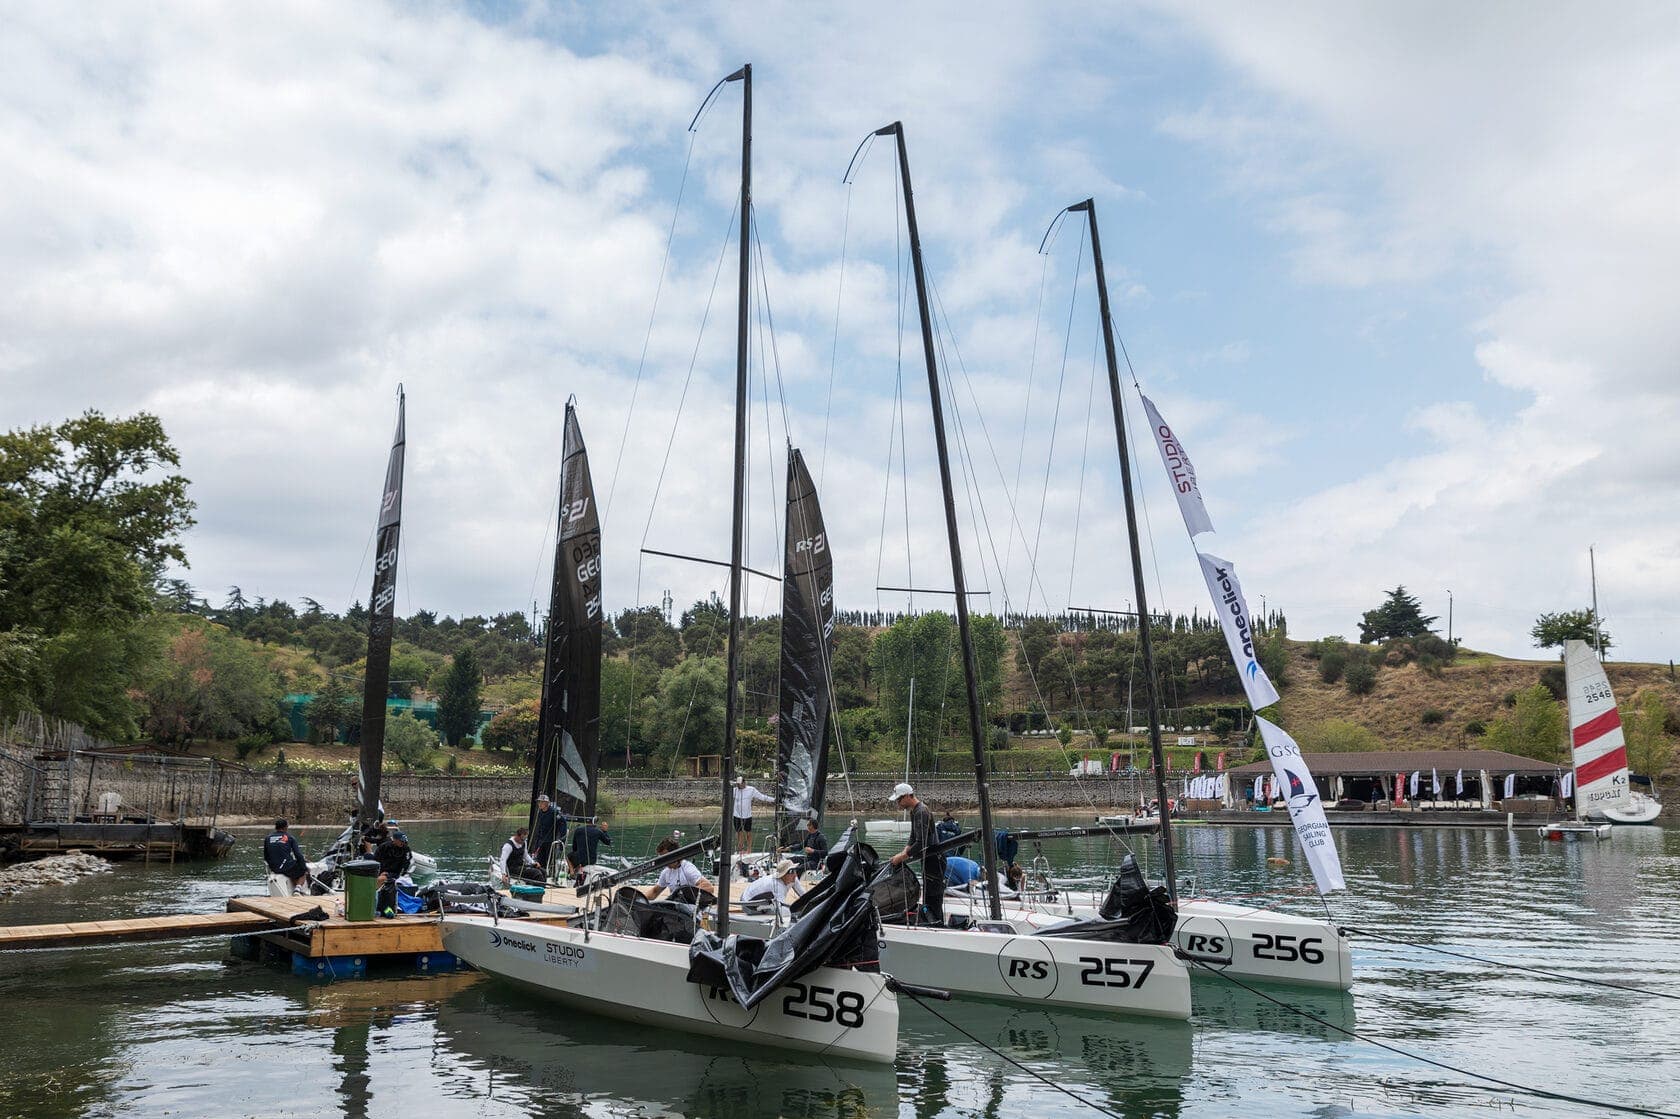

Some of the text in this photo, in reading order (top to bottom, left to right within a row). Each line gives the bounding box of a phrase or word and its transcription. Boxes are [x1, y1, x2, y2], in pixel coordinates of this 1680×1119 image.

[1158, 425, 1192, 494] STUDIO
[374, 585, 395, 615] 253
[820, 582, 833, 607] GE
[1586, 689, 1612, 703] 2546
[1309, 839, 1325, 848] CLUB
[543, 953, 580, 968] LIBERTY
[546, 942, 585, 959] STUDIO
[1187, 933, 1325, 965] RS 256
[1008, 957, 1155, 989] RS 257
[783, 982, 865, 1029] 258
